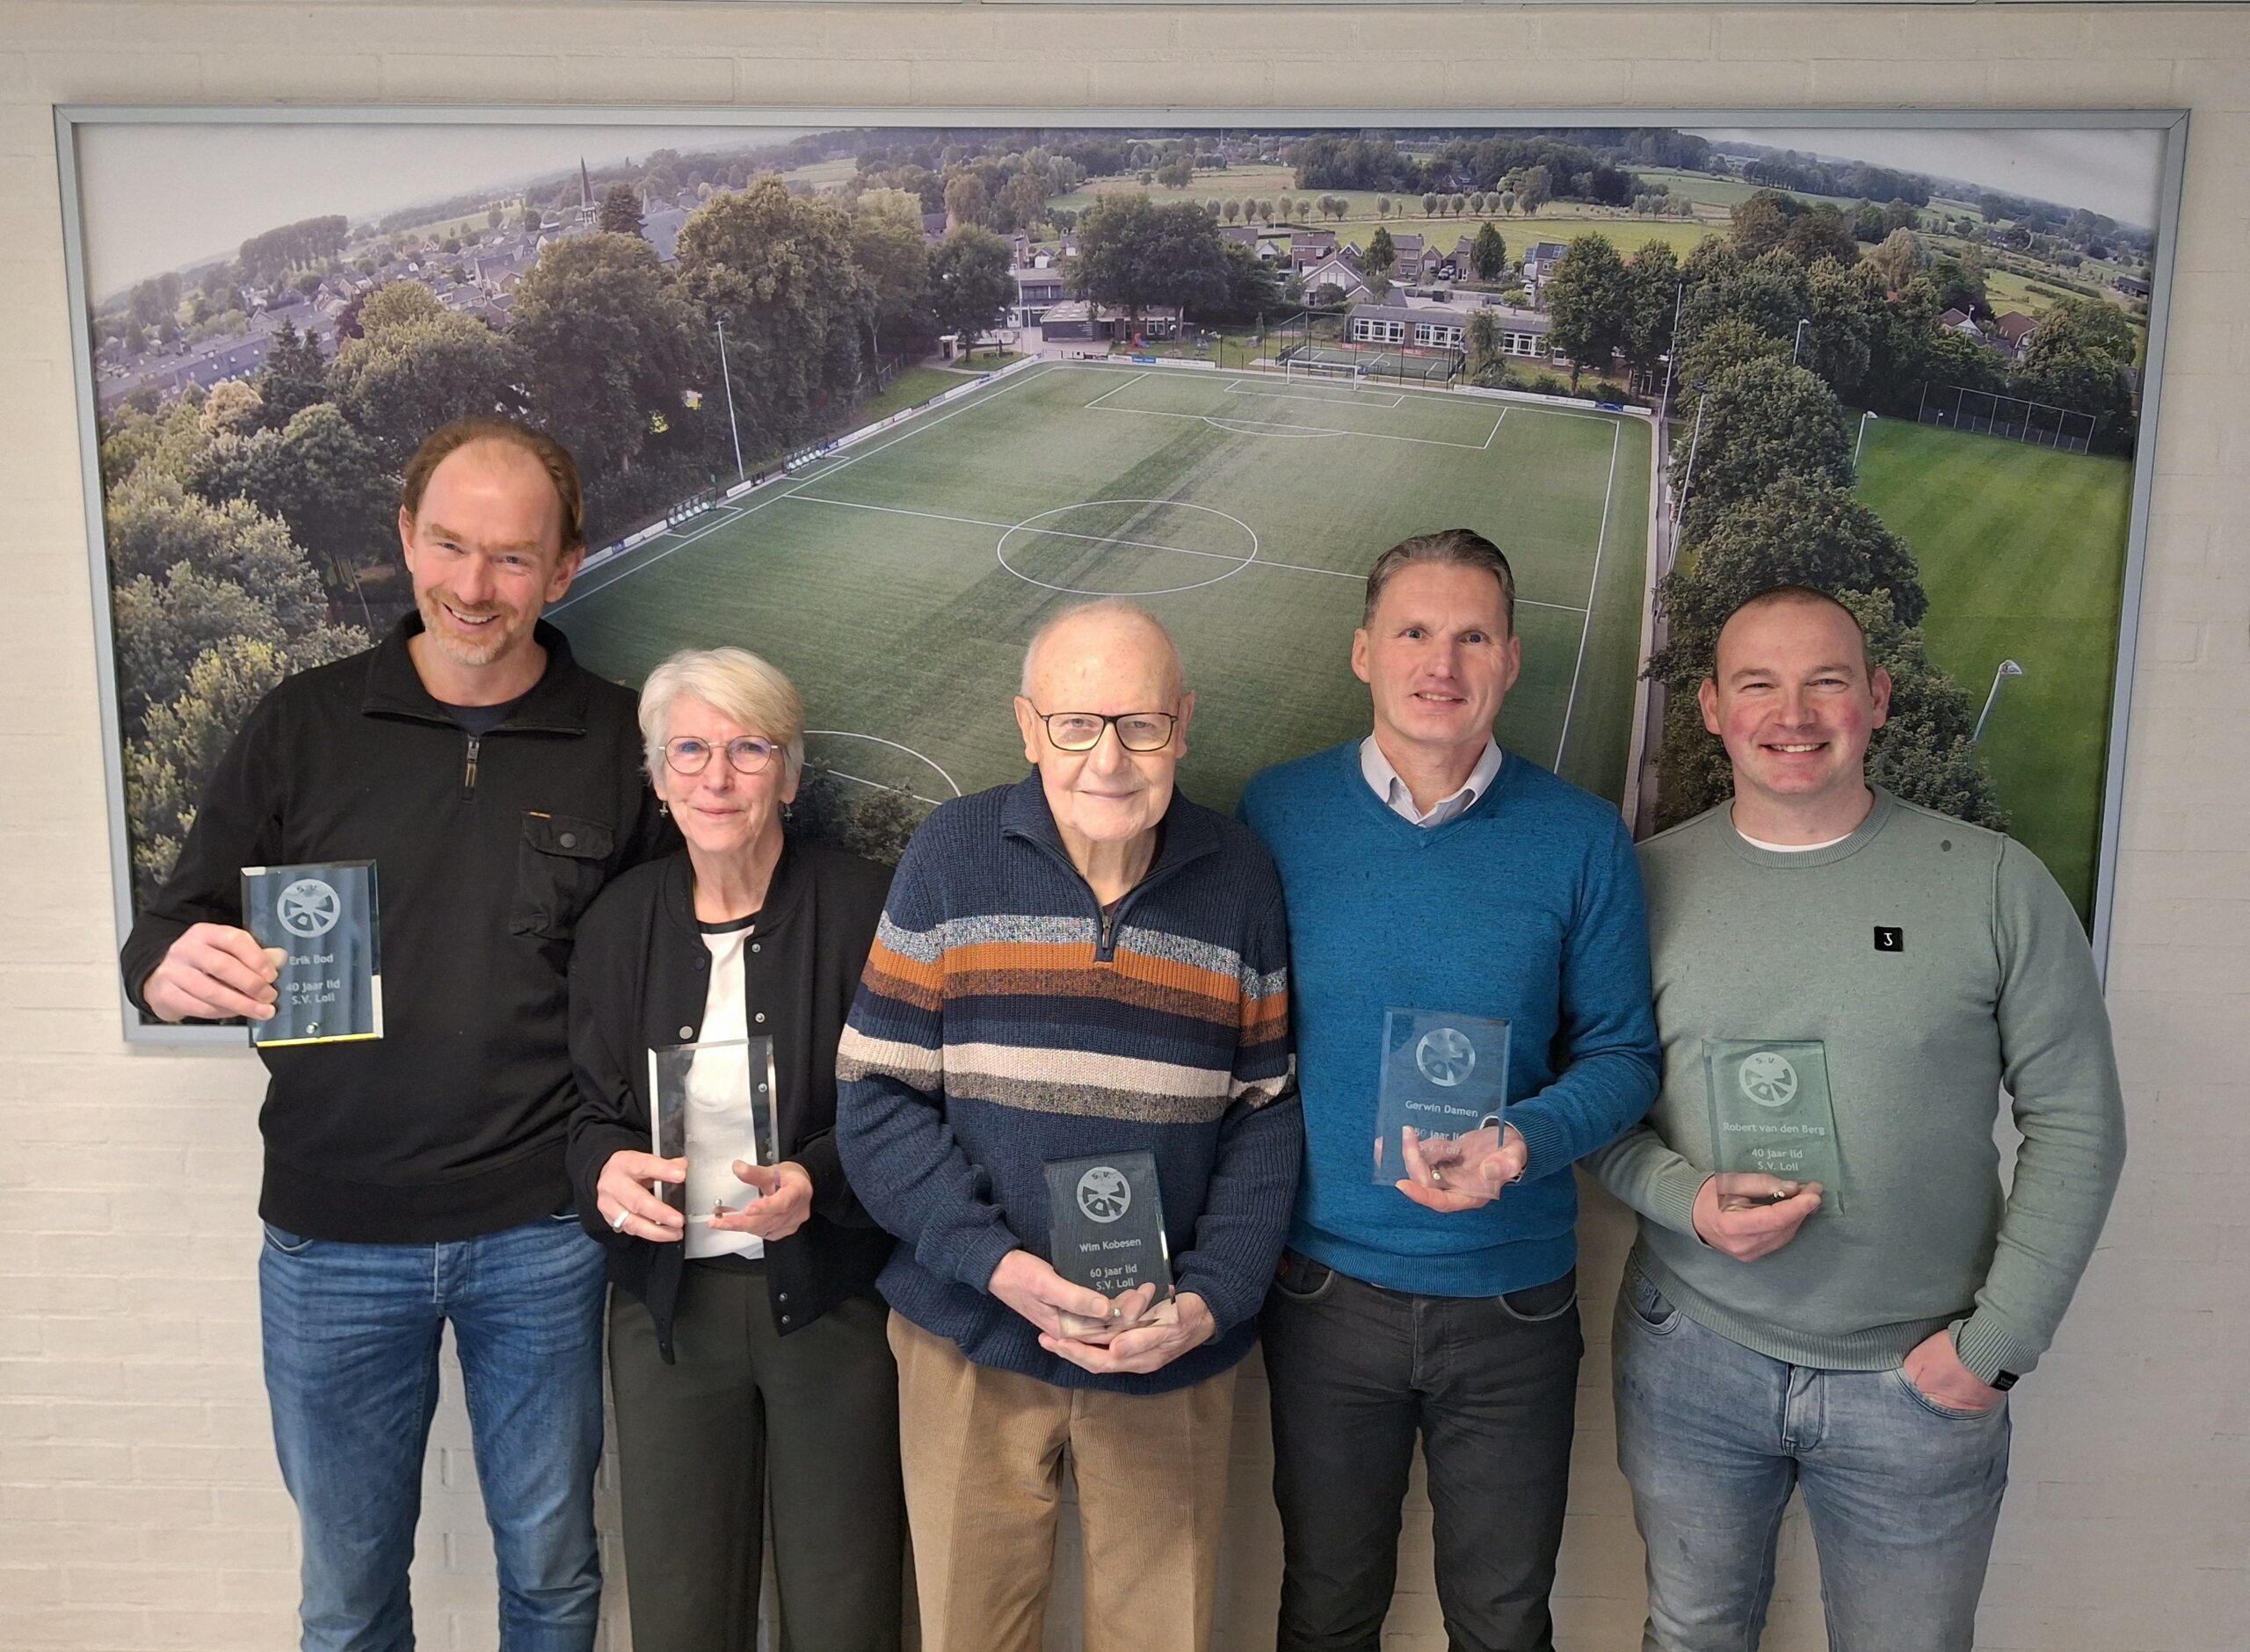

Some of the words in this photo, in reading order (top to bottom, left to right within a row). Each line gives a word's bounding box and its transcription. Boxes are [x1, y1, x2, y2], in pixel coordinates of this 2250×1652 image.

[289, 955, 310, 966] Erik
[301, 982, 324, 994] jaar
[326, 978, 341, 989] lid
[291, 994, 312, 1005] S.V.
[1405, 1100, 1441, 1113] Gerwin
[1444, 1105, 1479, 1118] Damen
[1723, 1122, 1758, 1132] Robert
[1780, 1125, 1799, 1134] den
[1802, 1125, 1825, 1136] Berg
[1751, 1148, 1765, 1158] 40
[1767, 1148, 1788, 1160] jaar
[1789, 1148, 1804, 1159] lid
[1758, 1161, 1776, 1171] S.V.
[1780, 1162, 1800, 1172] Loil
[1078, 1242, 1100, 1253] Wim
[1102, 1238, 1142, 1250] Kobesen
[1090, 1267, 1102, 1278] 60
[1104, 1266, 1123, 1278] jaar
[1125, 1263, 1138, 1274] lid
[1095, 1280, 1114, 1291] S.V.
[1116, 1277, 1135, 1288] Loil
